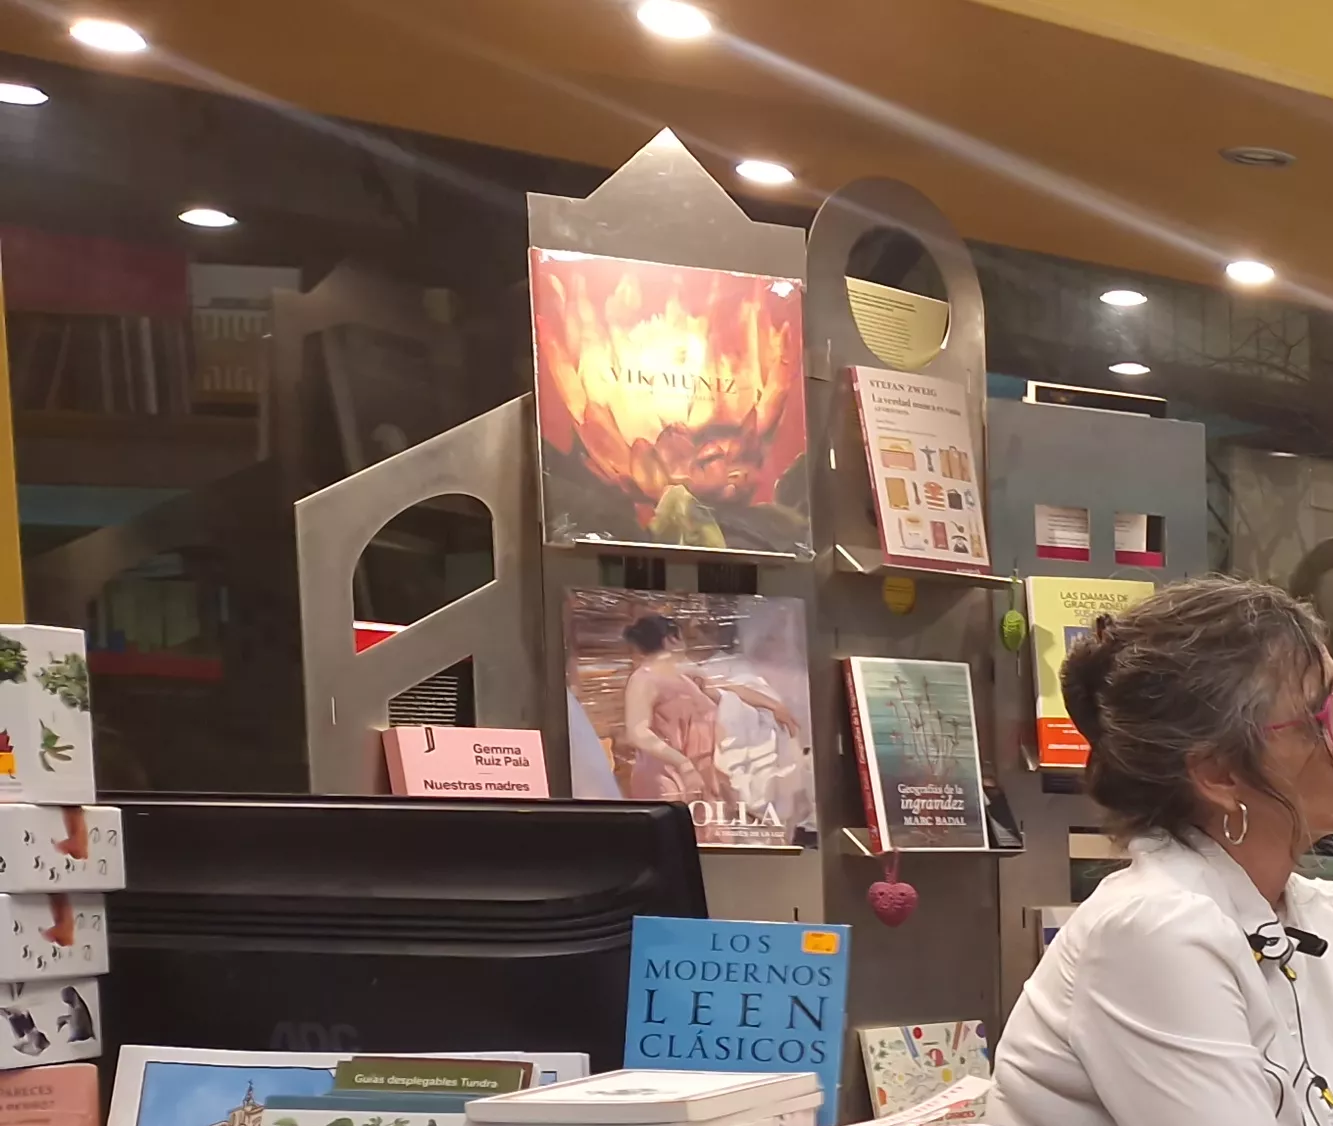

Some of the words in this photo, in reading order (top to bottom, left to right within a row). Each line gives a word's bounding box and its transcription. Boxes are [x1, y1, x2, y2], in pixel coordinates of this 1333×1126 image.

[472, 744, 522, 756] Gemma
[475, 756, 501, 767] Ruiz
[423, 779, 482, 791] Nuestras
[485, 781, 531, 792] madres
[711, 932, 772, 955] LOS
[645, 958, 833, 987] MODERNOS
[644, 989, 829, 1031] LEEN
[639, 1031, 827, 1064] CLÁSICOS
[388, 1075, 458, 1089] desplegables
[461, 1077, 499, 1089] Tundra
